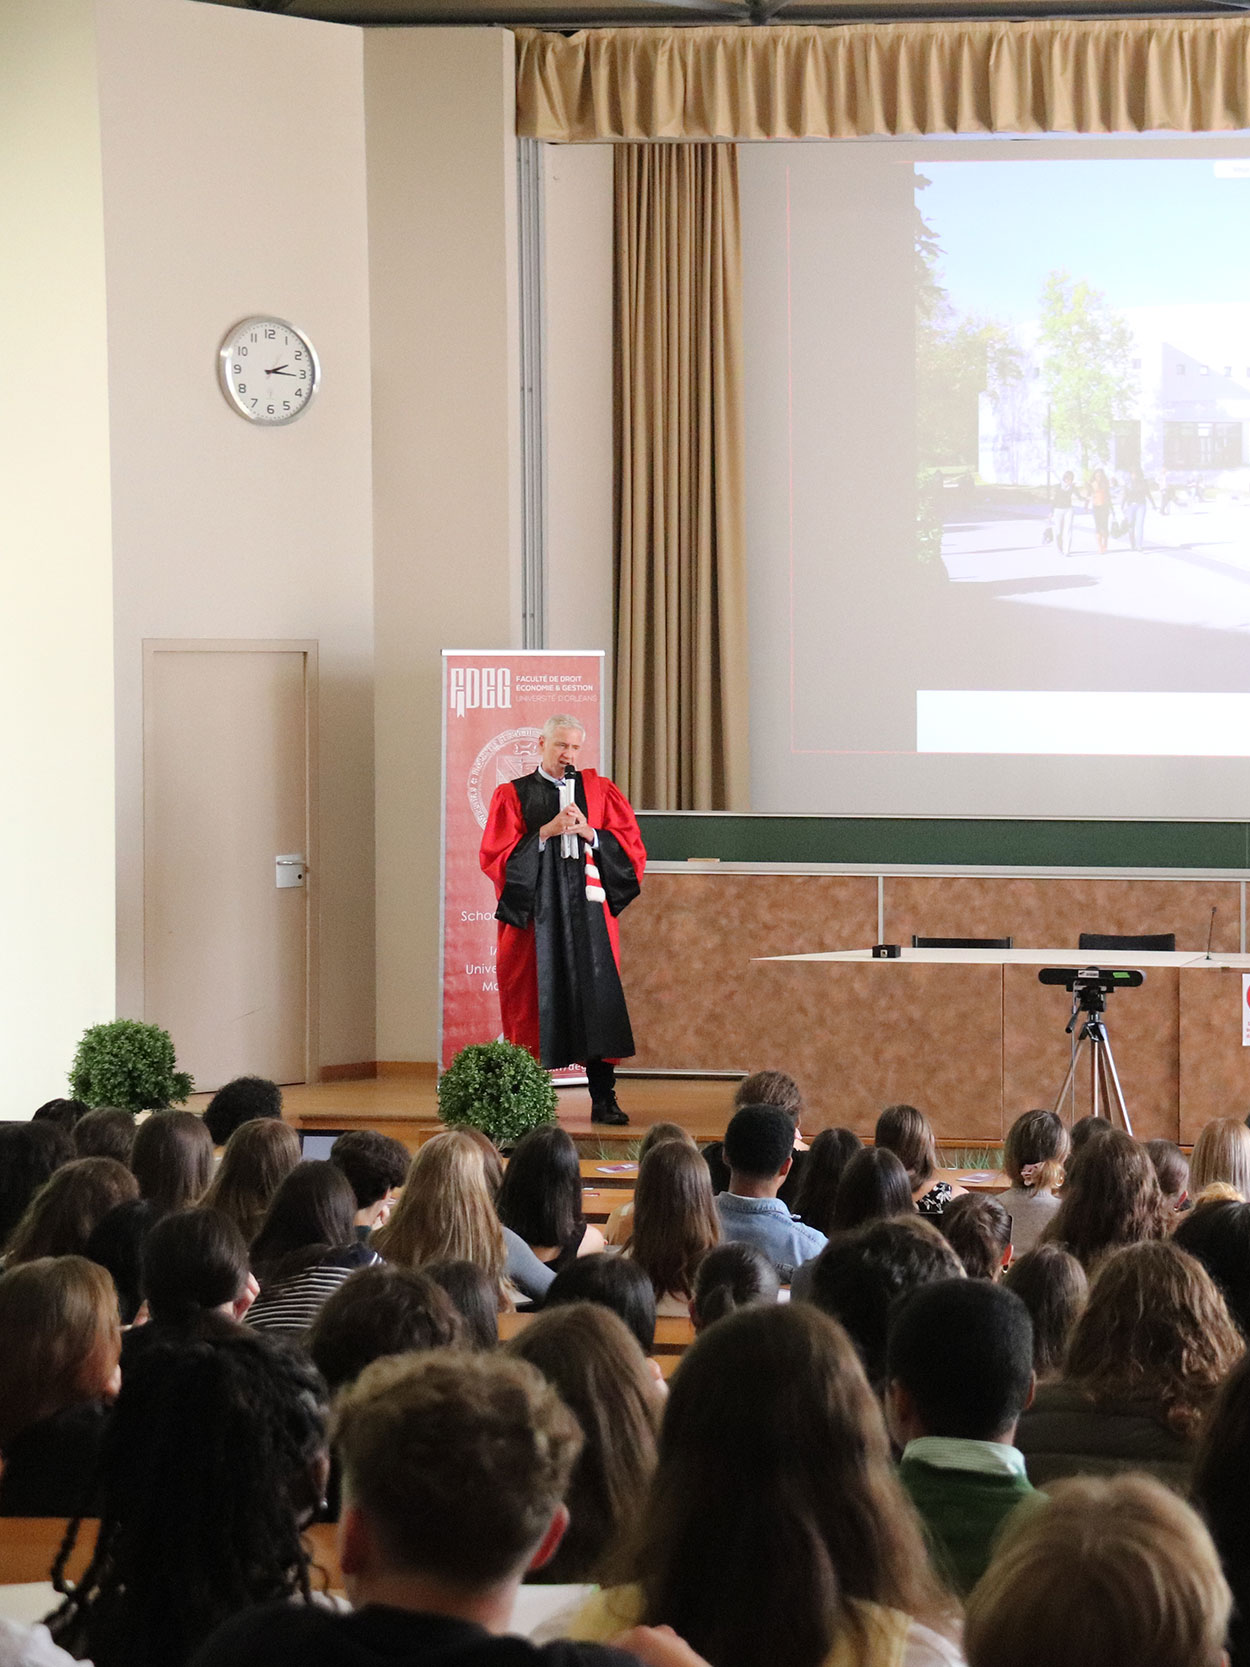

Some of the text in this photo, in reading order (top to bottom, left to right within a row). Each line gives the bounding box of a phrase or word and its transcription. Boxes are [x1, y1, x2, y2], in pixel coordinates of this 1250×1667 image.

[250, 333, 258, 343] 11
[264, 329, 276, 339] 12
[238, 346, 248, 357] 10
[294, 350, 302, 361] 2
[234, 364, 242, 374] 9
[299, 370, 306, 379] 3
[238, 383, 246, 394] 8
[294, 388, 302, 398] 4
[250, 398, 258, 408] 7
[283, 401, 290, 411] 5
[267, 404, 274, 414] 6
[516, 674, 548, 682] FACULTÉ
[450, 668, 512, 718] FDEG
